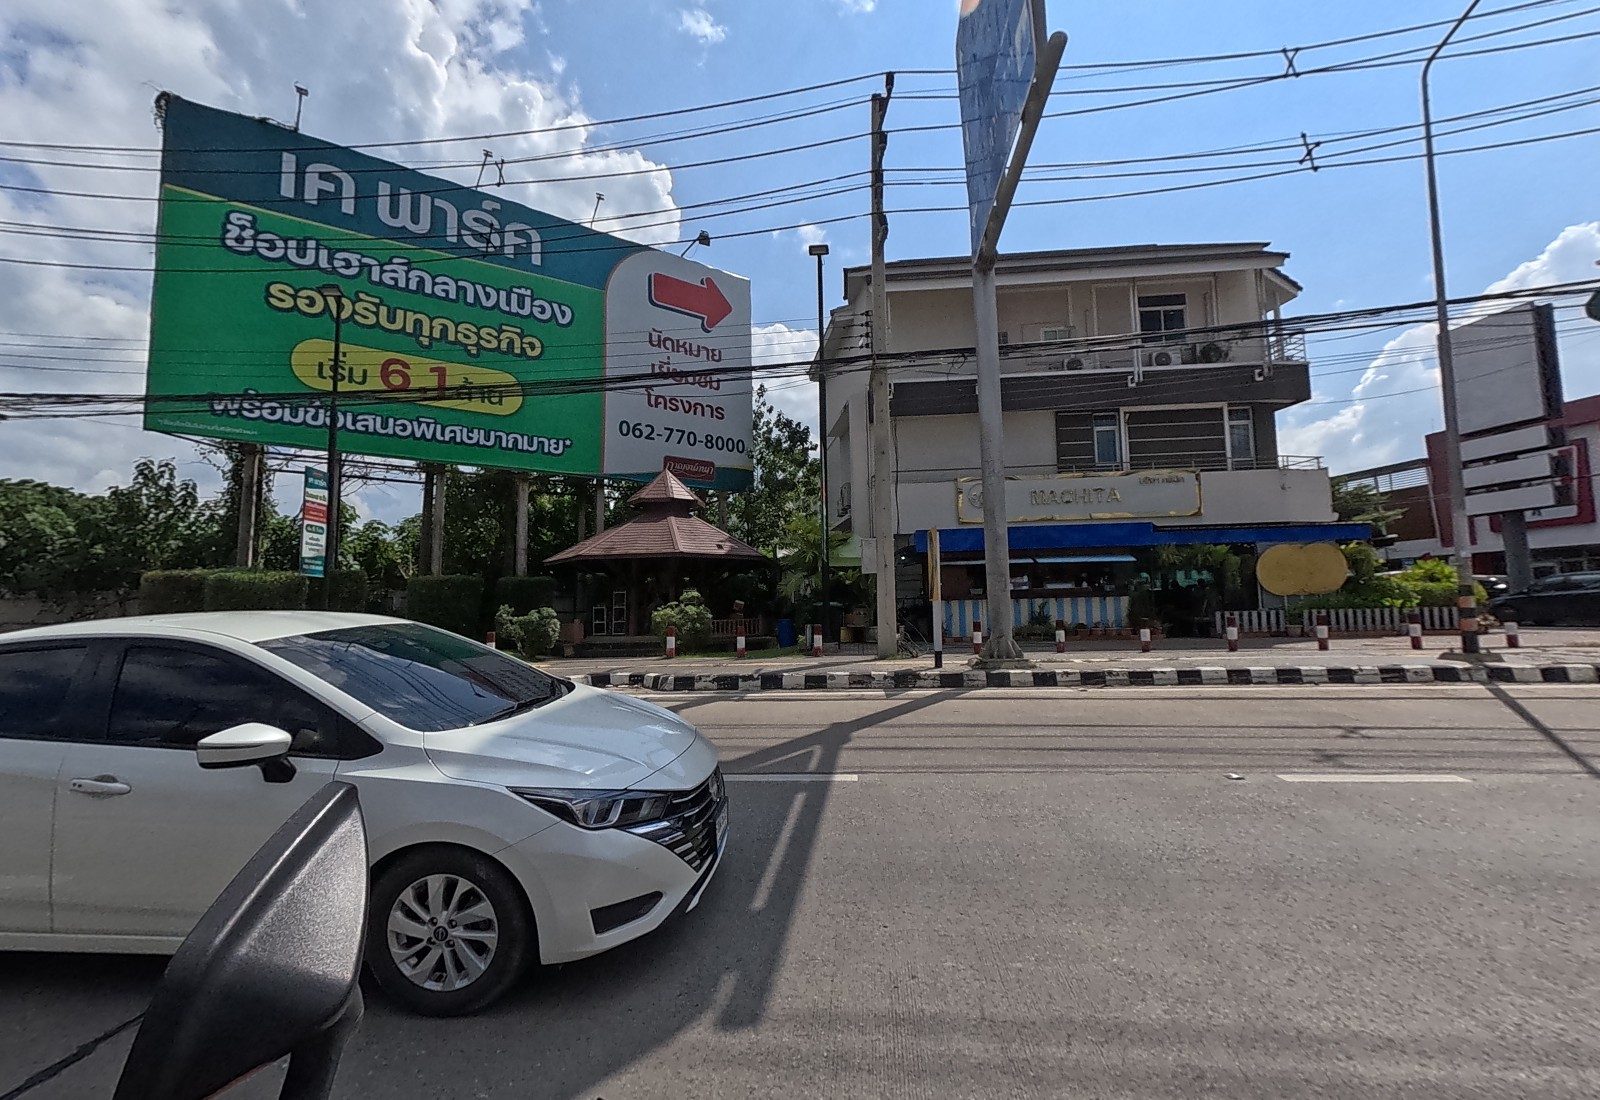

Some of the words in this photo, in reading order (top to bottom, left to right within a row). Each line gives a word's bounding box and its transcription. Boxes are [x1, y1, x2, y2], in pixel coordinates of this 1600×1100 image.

[280, 151, 356, 215] เค
[377, 181, 541, 266] พาร์ค
[267, 283, 542, 358] รองรับทุกธุรกิจ
[648, 328, 722, 362] นัดหมาย
[317, 351, 368, 386] เริ่ม
[645, 386, 726, 420] โครงการ
[618, 420, 746, 454] 062-770-8000
[1030, 488, 1122, 506] MACHITA
